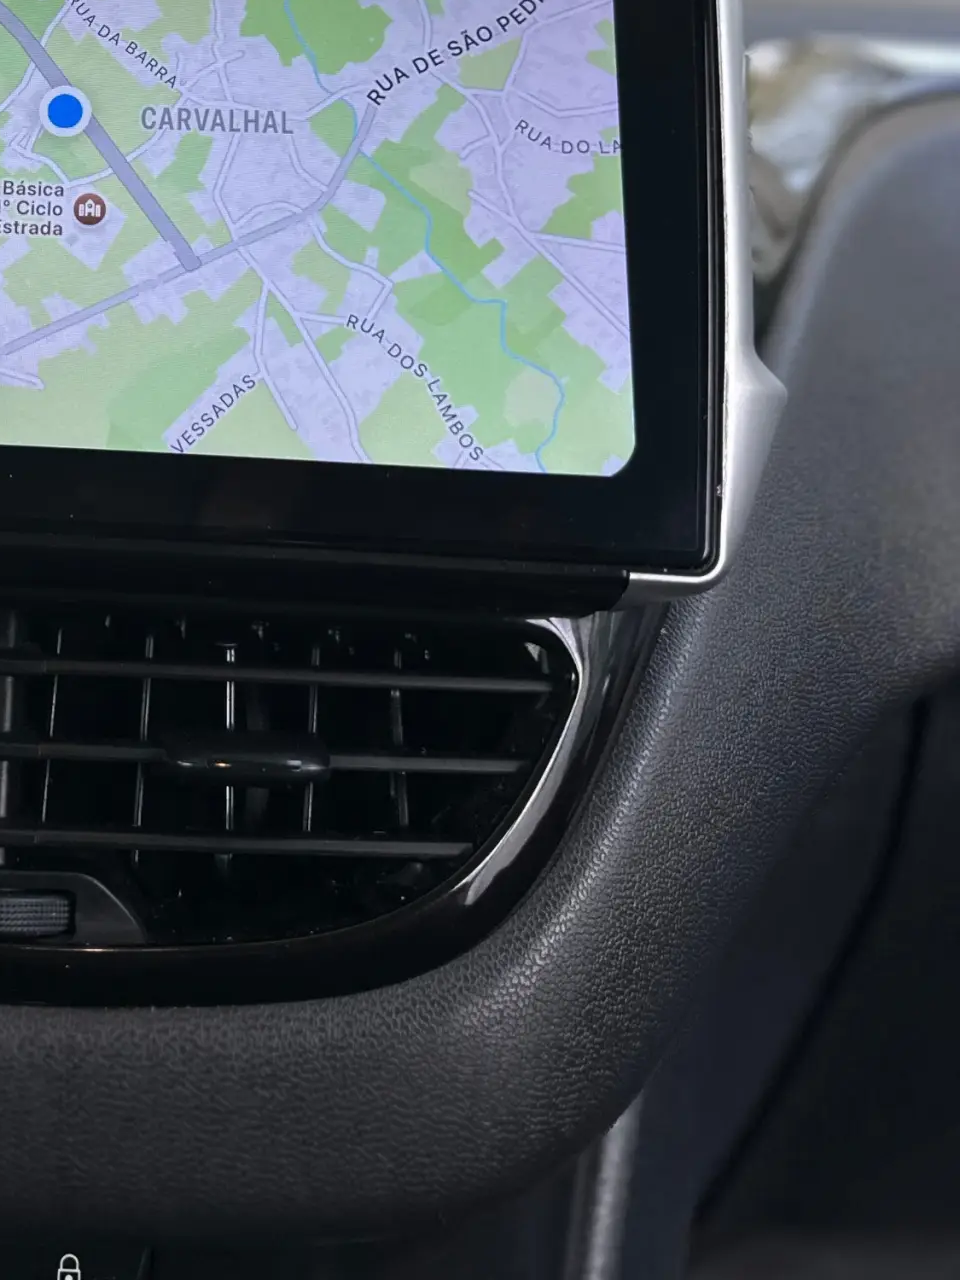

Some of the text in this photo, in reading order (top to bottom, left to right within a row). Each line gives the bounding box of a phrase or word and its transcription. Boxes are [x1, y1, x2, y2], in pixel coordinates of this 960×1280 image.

[97, 24, 120, 46] DA
[125, 41, 177, 89] BARRA
[366, 66, 410, 106] RUA
[412, 49, 445, 74] DE
[447, 26, 493, 57] SÃO
[141, 106, 294, 134] CARVALHAL
[515, 119, 552, 150] RUA
[561, 140, 590, 154] DO
[3, 180, 64, 197] Básica
[16, 200, 63, 216] Ciclo
[346, 314, 485, 461] RUA DOS LAMBOS
[170, 374, 256, 454] VESSADAS
